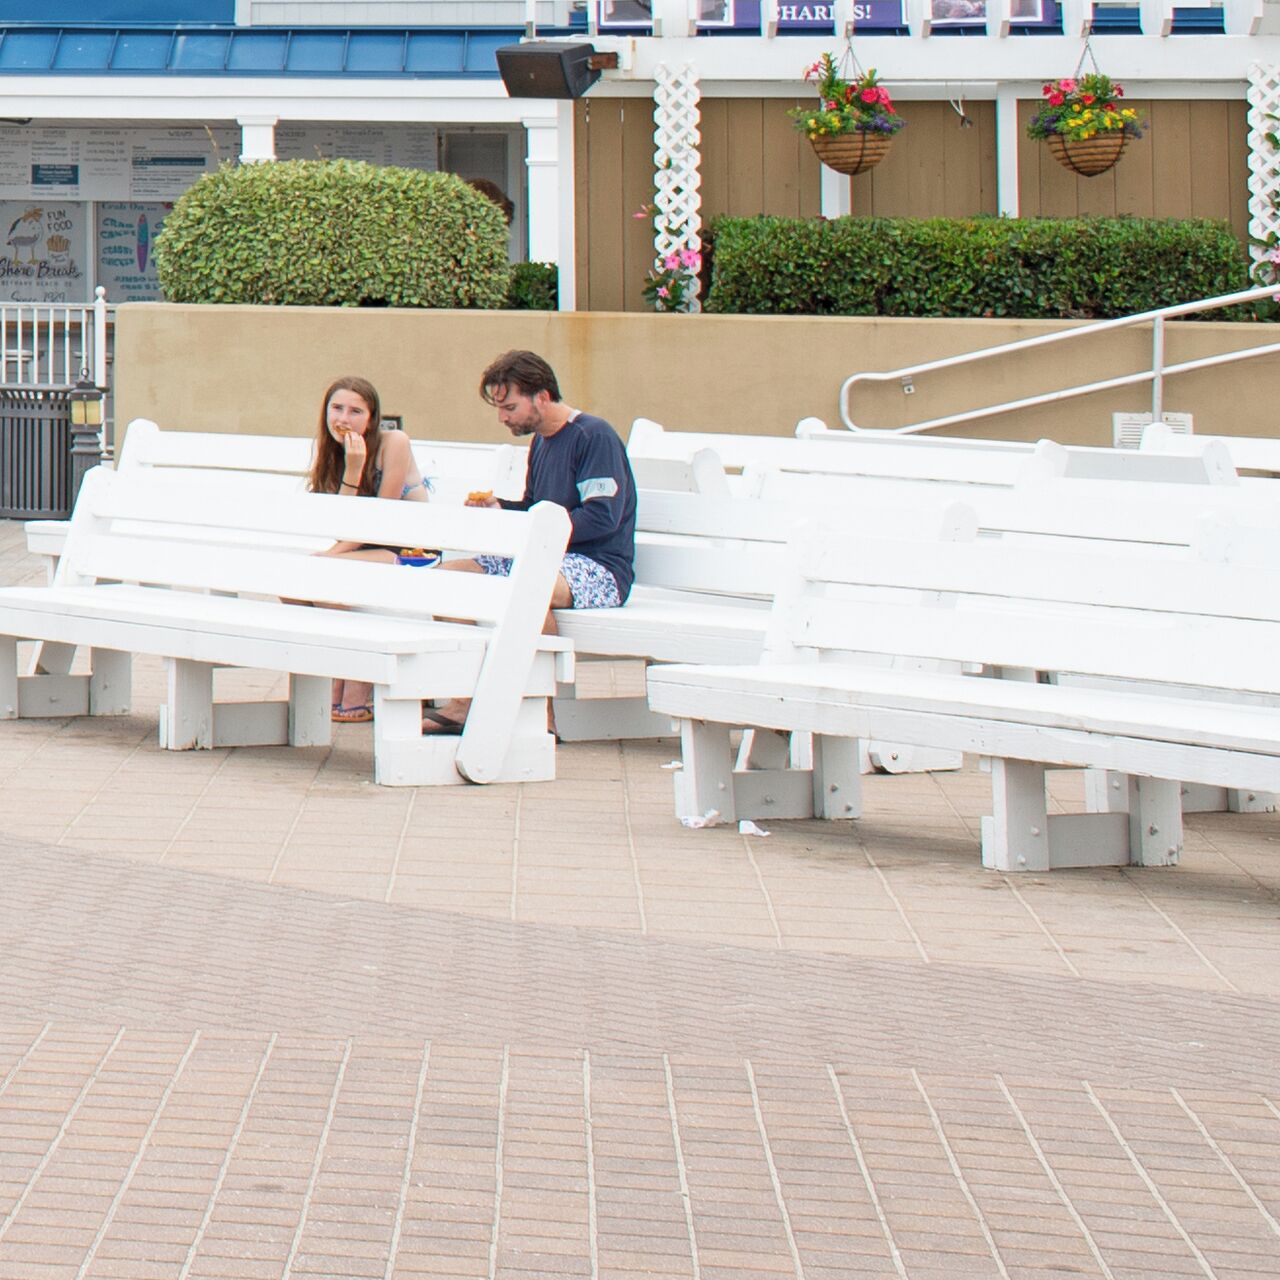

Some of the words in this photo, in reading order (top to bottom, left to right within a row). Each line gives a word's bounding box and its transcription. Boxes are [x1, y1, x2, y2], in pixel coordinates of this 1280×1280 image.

[46, 208, 67, 222] FUN
[46, 220, 73, 232] FOOD
[37, 259, 83, 280] Break
[10, 289, 37, 302] Since
